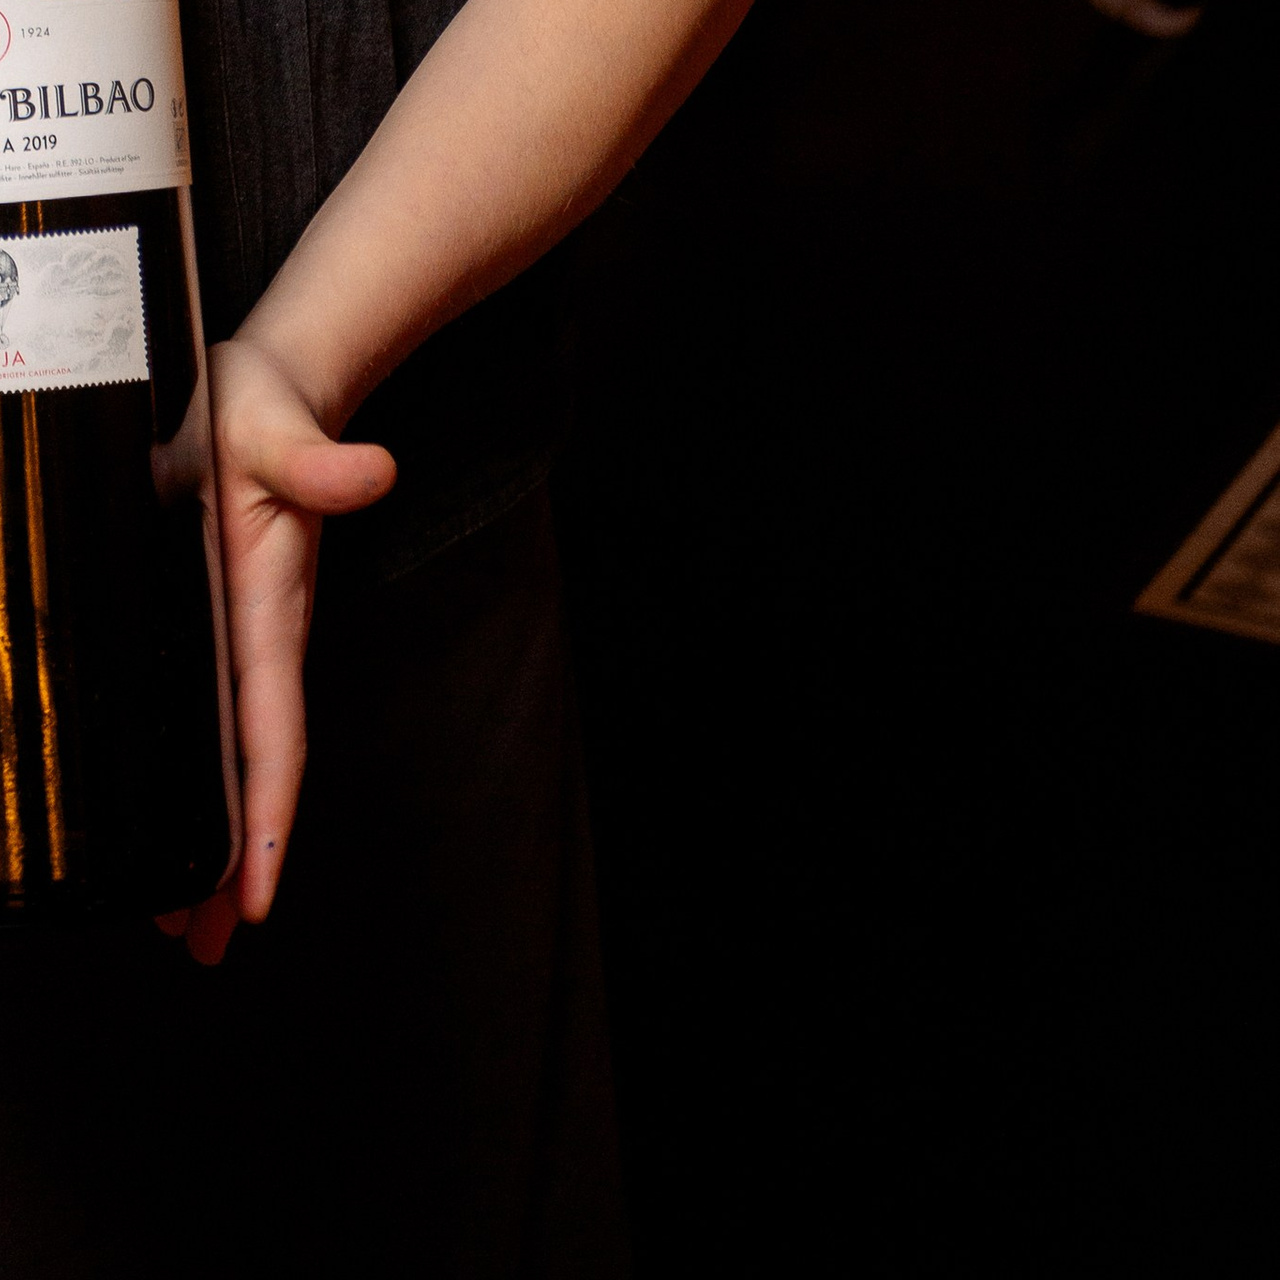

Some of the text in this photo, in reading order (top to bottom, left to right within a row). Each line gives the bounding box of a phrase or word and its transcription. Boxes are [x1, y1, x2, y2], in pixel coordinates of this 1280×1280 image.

[21, 27, 50, 38] 1924
[23, 134, 58, 151] 2019
[28, 367, 72, 378] CALIFICADA
